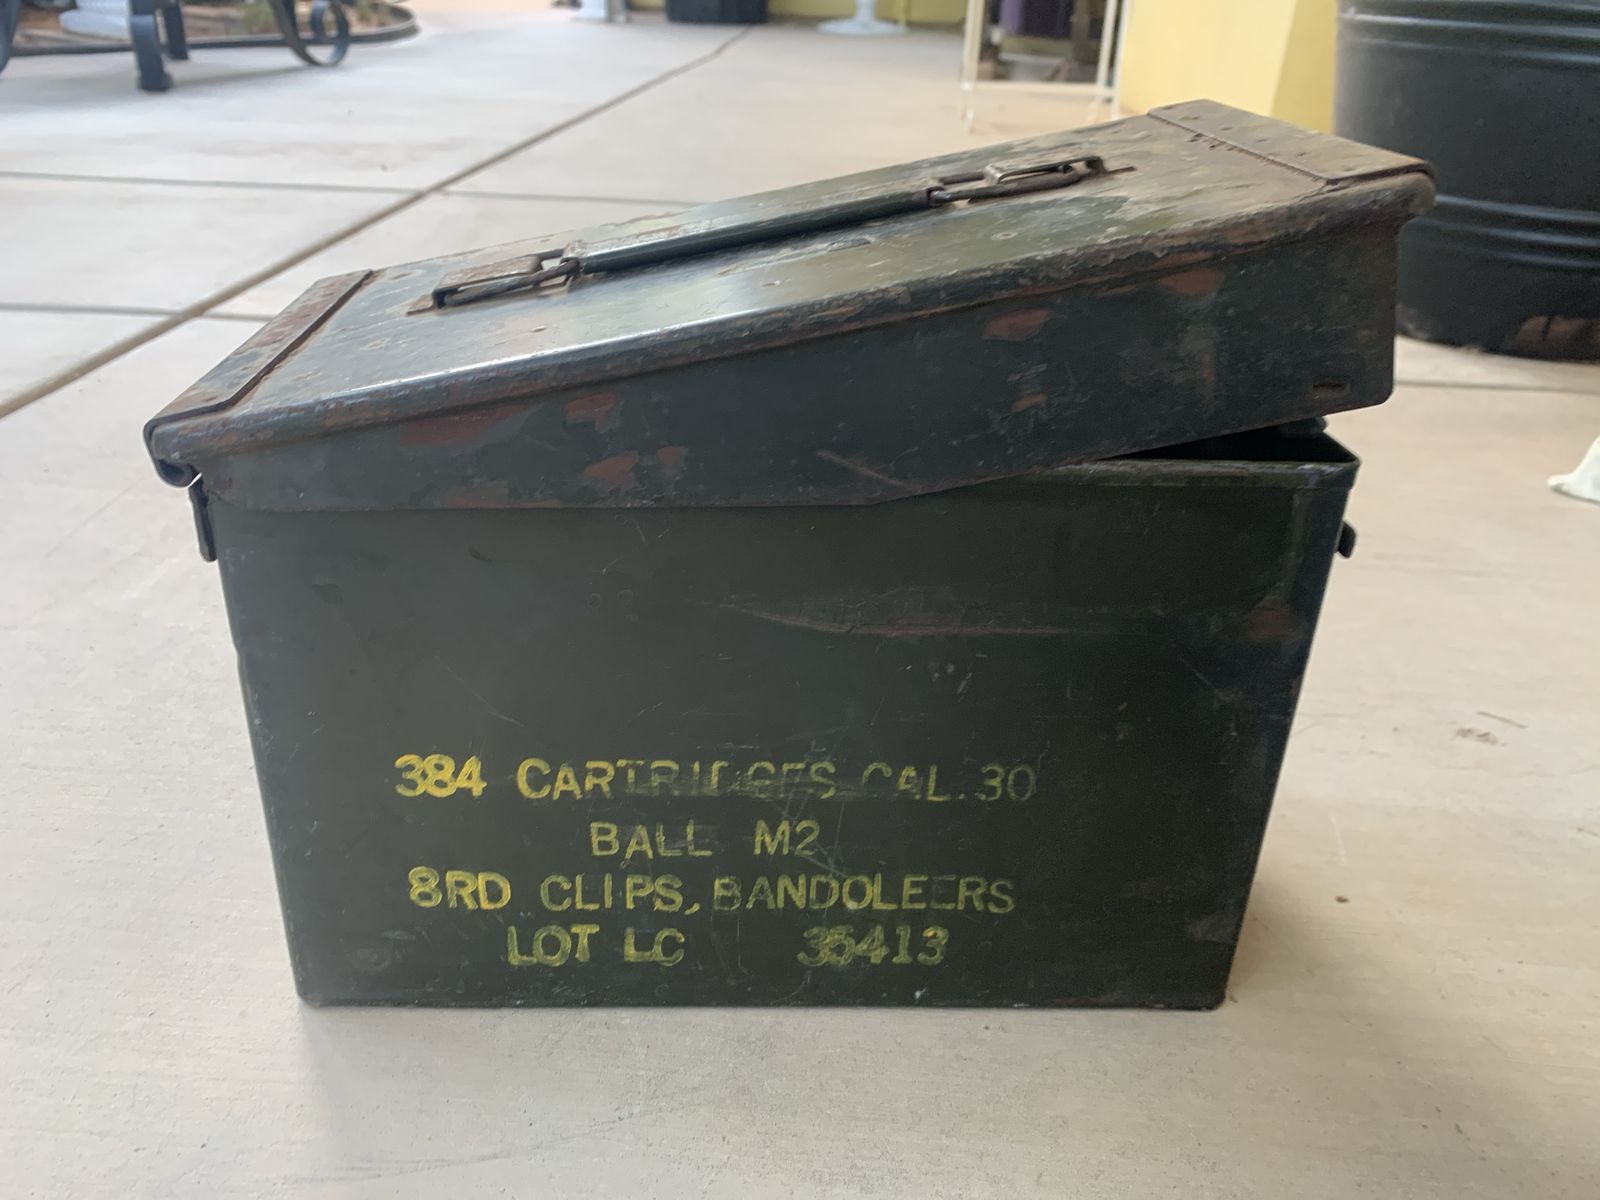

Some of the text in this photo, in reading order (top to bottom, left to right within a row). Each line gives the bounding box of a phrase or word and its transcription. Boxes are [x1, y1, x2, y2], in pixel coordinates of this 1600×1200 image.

[394, 754, 487, 798] 384
[590, 819, 820, 860] BALL M2
[408, 866, 1016, 915] 8RD CLIPS, BANDOLEERS
[507, 923, 600, 967] LOT
[623, 927, 686, 967] LC
